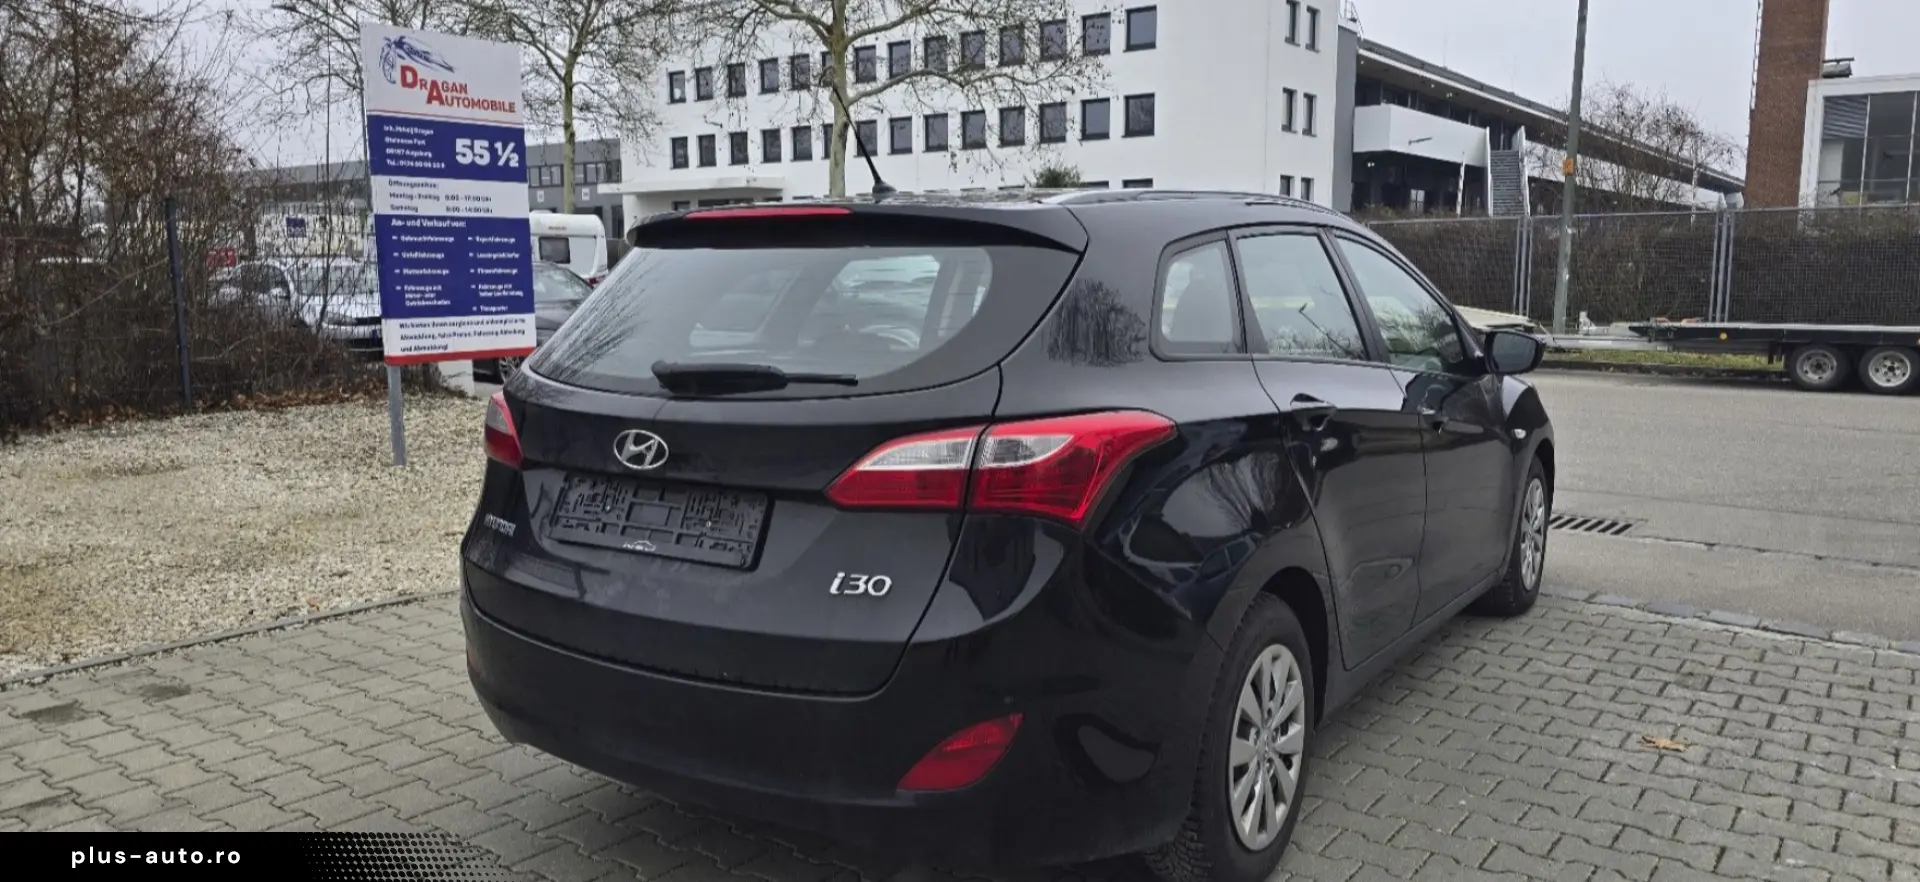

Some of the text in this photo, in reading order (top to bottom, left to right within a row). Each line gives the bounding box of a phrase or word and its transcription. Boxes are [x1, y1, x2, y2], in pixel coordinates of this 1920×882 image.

[400, 64, 468, 102] DRAGAN
[426, 80, 516, 113] AUTOMOBILE
[455, 138, 491, 166] 55
[389, 192, 414, 201] Montag
[391, 218, 466, 228] An- und Verkauf von:
[400, 345, 412, 353] und
[829, 571, 893, 597] i30
